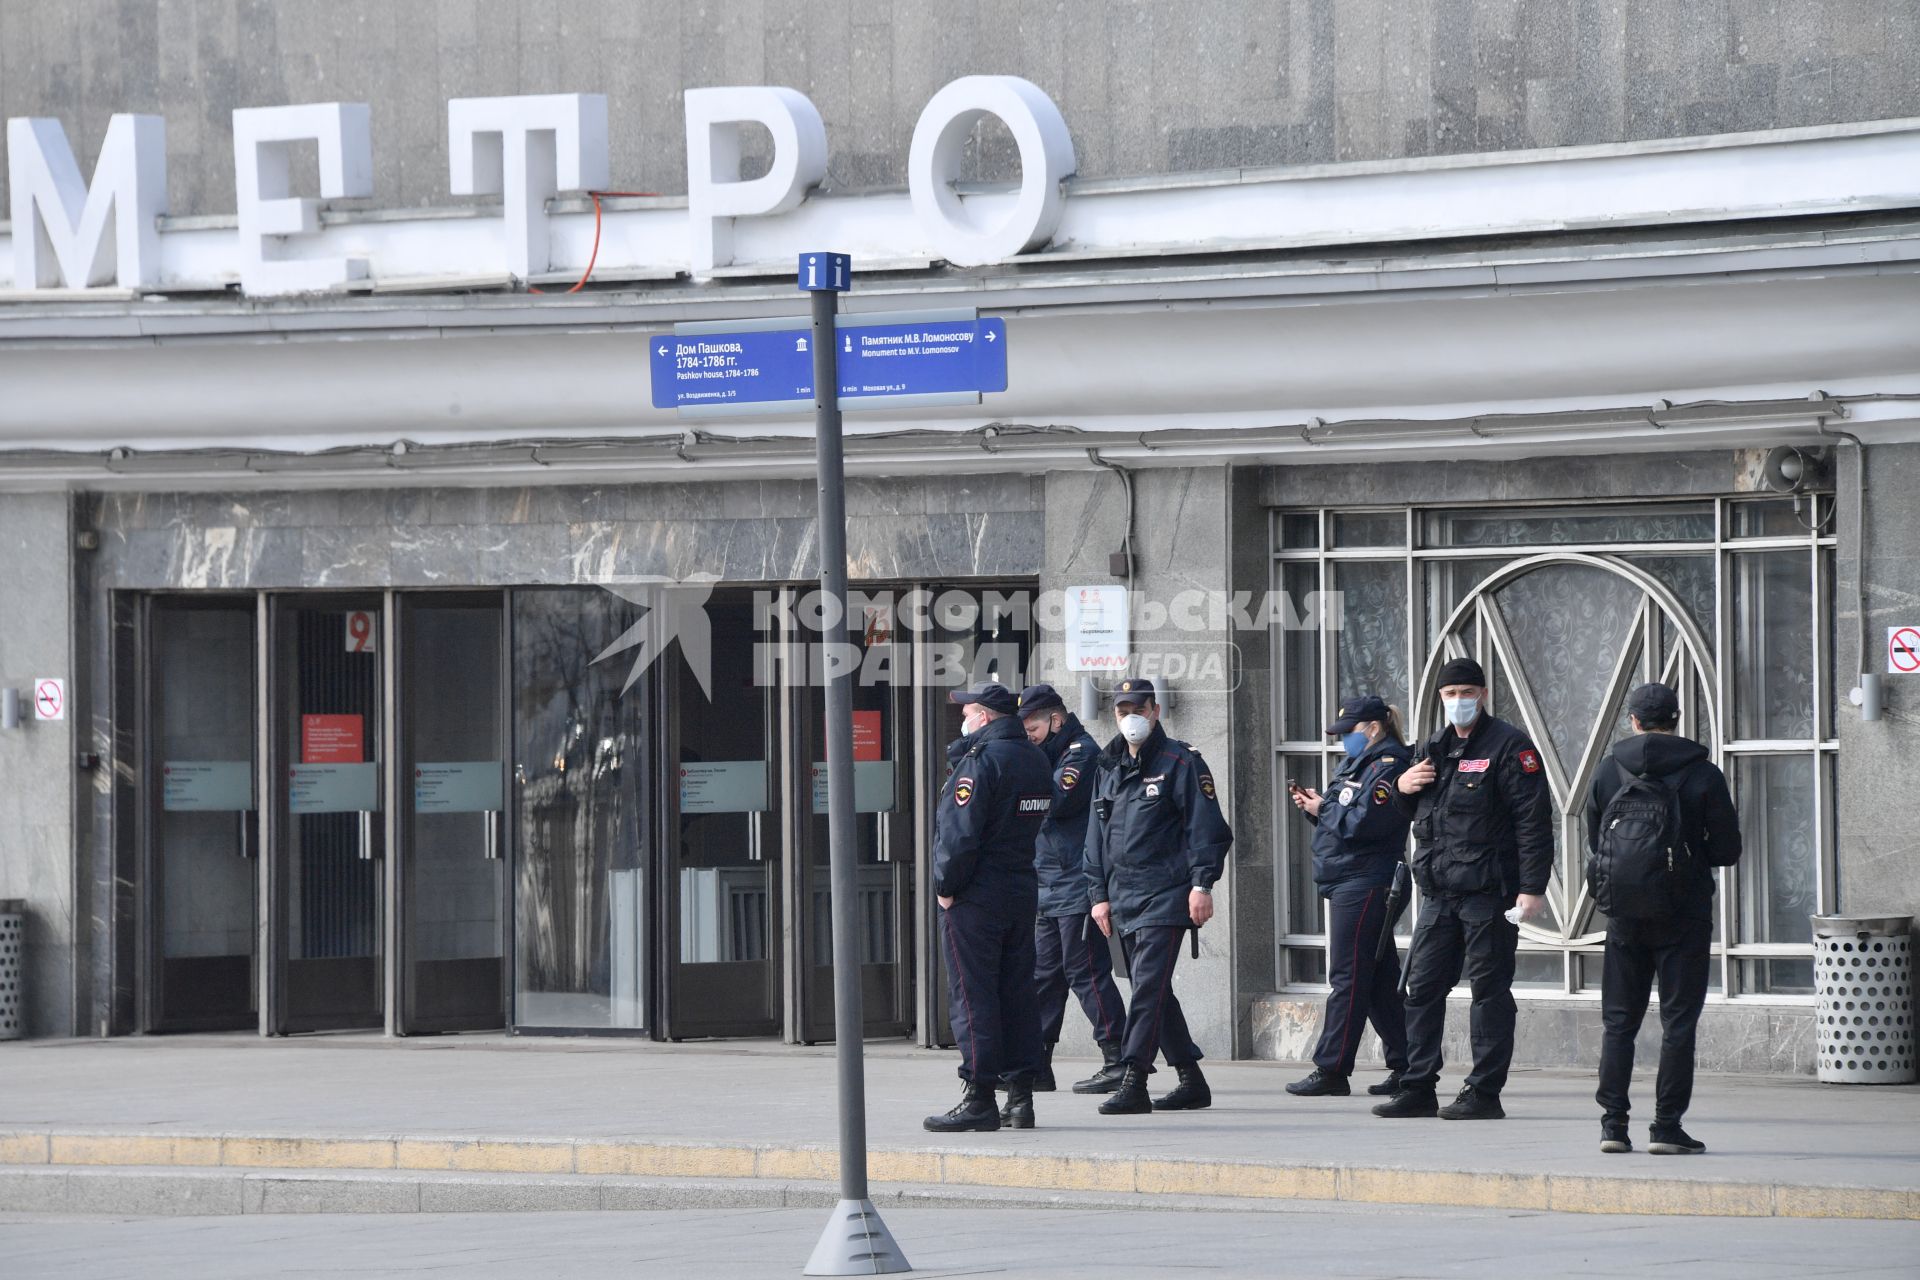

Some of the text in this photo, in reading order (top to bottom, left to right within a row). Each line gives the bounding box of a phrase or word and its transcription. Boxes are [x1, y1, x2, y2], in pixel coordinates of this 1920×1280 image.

[6, 74, 1078, 298] МЕТРО
[861, 332, 974, 346] Памятник М.В. Ломоносову
[675, 342, 743, 357] Дом Пашкова,
[861, 345, 960, 358] Monument to M.V. Lomonosov
[676, 355, 738, 369] 1784-1786 гг.
[676, 368, 759, 380] Pashkov house, 1784-1786
[800, 386, 811, 394] min
[846, 385, 858, 393] min
[1019, 798, 1052, 812] ПОЛИЦИ
